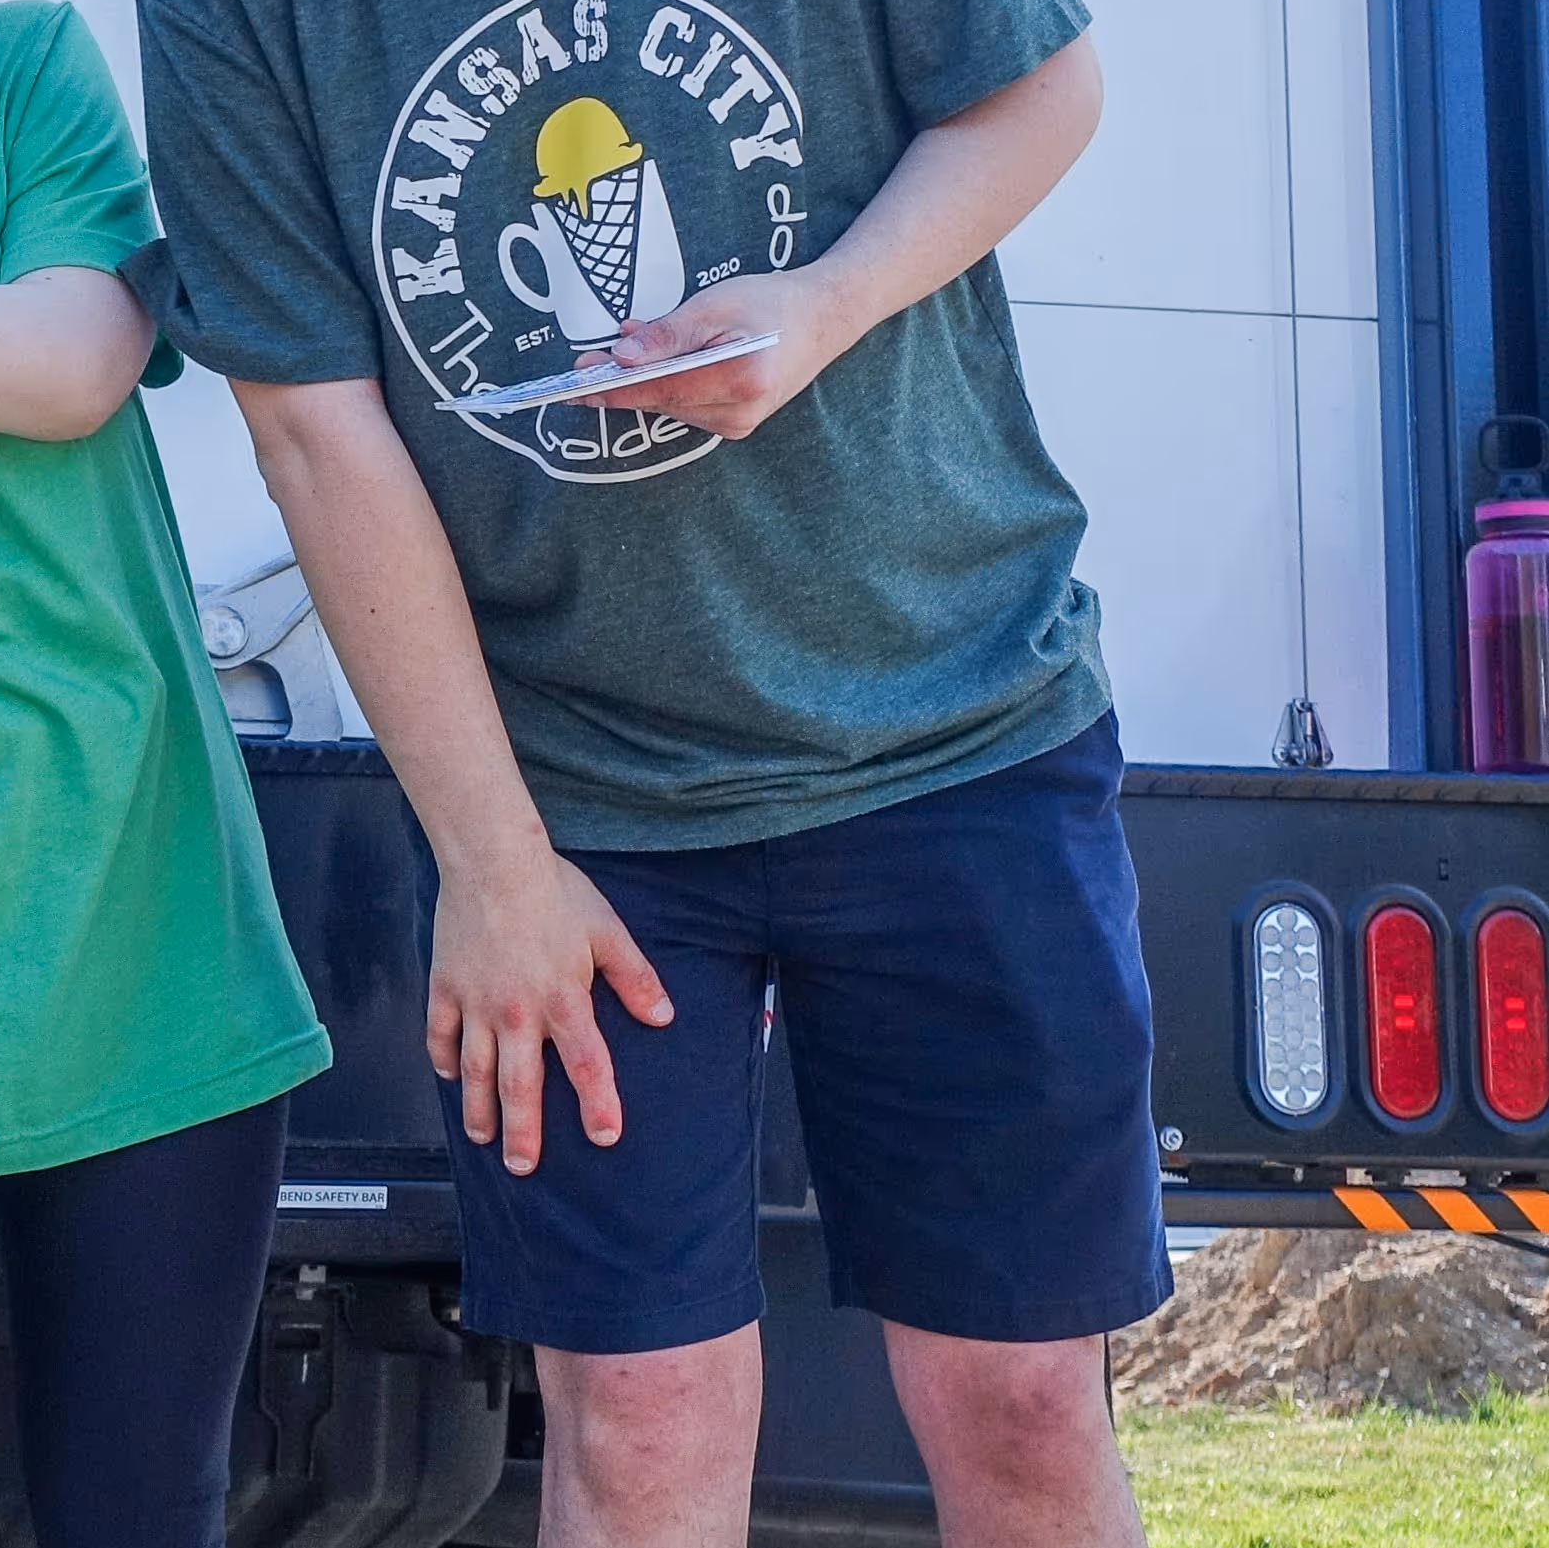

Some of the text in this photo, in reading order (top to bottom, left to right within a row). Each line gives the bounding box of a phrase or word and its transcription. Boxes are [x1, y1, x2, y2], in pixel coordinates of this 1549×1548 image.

[639, 6, 804, 170] CITY
[697, 257, 741, 288] 2020
[514, 326, 554, 352] EST.
[535, 404, 689, 460] Golde
[280, 1191, 384, 1202] BEND SAFETY BAR
